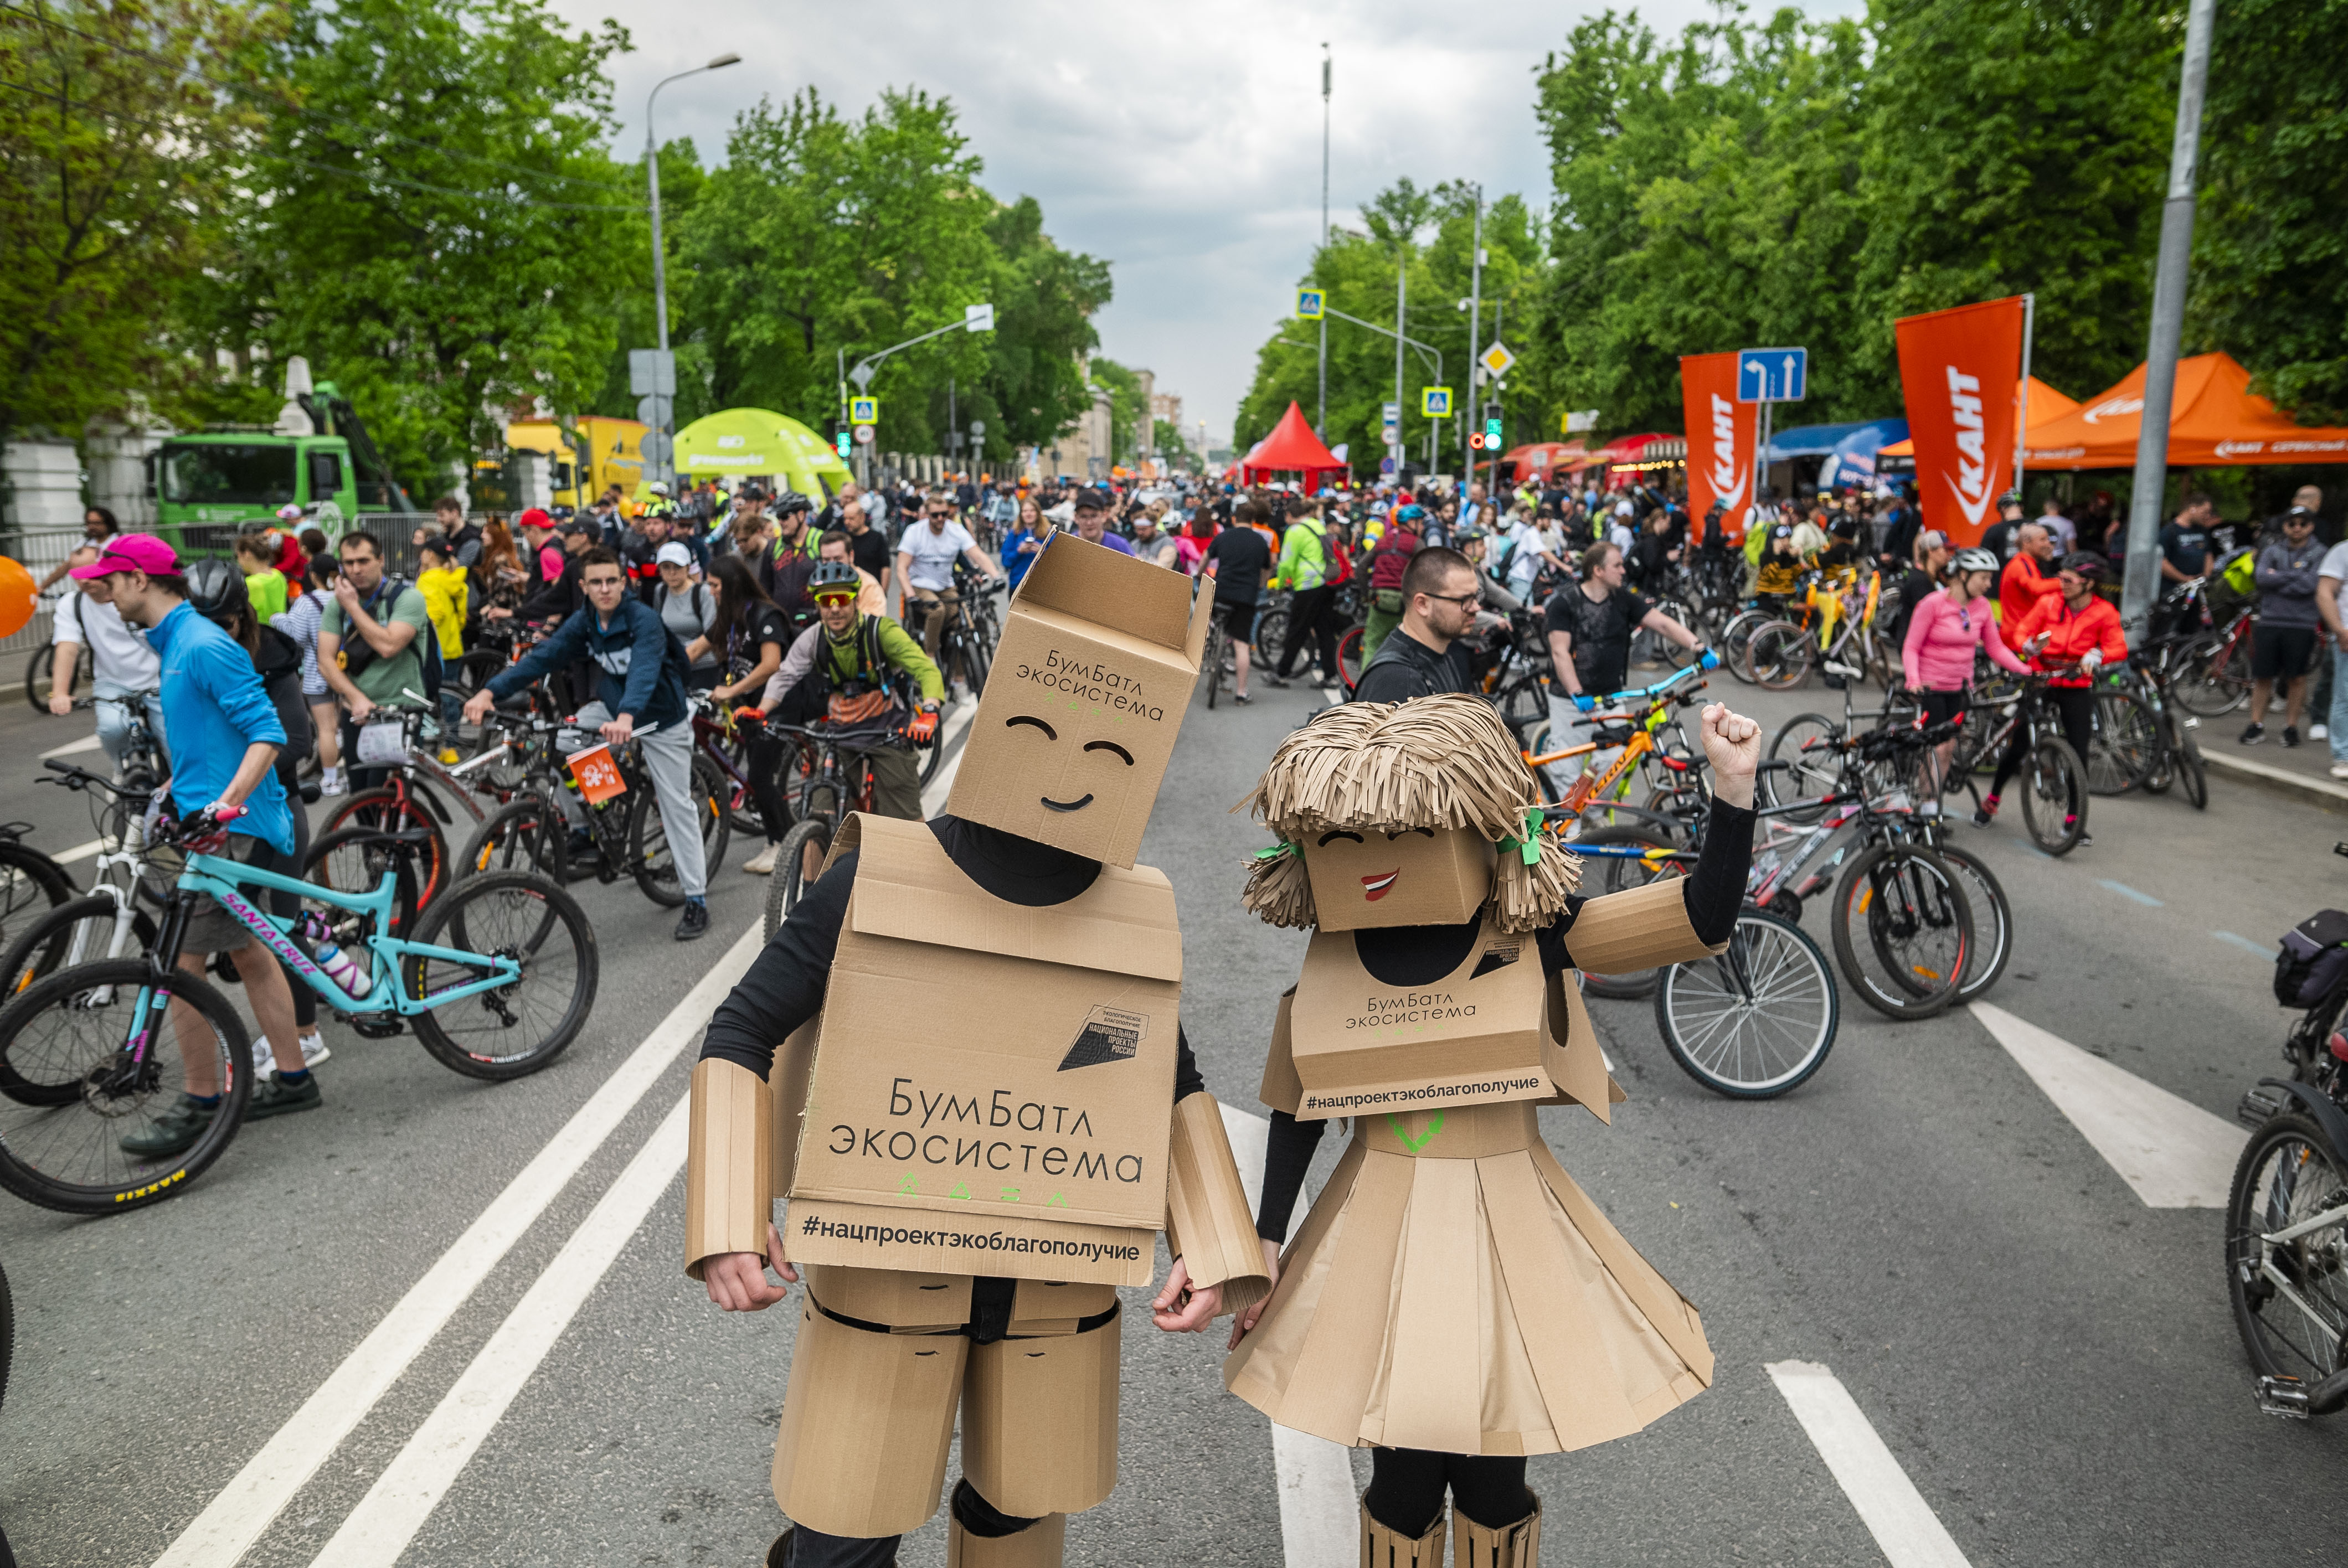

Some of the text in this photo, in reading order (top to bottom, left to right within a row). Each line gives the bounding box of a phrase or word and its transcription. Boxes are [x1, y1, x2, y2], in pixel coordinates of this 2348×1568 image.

[1711, 393, 1734, 490] КАНТ
[1947, 364, 1985, 499] КАНТ
[1046, 649, 1141, 696] БумБатл
[1016, 664, 1163, 722] экосистема
[221, 893, 316, 976] SANTA CRUZ
[1103, 1010, 1142, 1023] ЭКОЛОГИЧЕСКОЕ
[1346, 1005, 1476, 1029] экосистема
[1368, 993, 1453, 1013] БумБатл
[1089, 1024, 1137, 1040] НАЦИОНАЛЬНЫЕ
[1104, 1017, 1141, 1028] БЛАГОПОЛУЧИЕ
[1108, 1035, 1136, 1048] ПРОЕКТЫ
[1111, 1046, 1135, 1056] РОССИИ
[889, 1077, 1093, 1137] БумБатл
[1306, 1077, 1539, 1110] #нацпроектэкоблагополучие
[829, 1125, 1143, 1183] экосистема
[115, 1169, 186, 1202] MAXXIS
[802, 1216, 1140, 1263] #нацпроектэкоблагополучие
